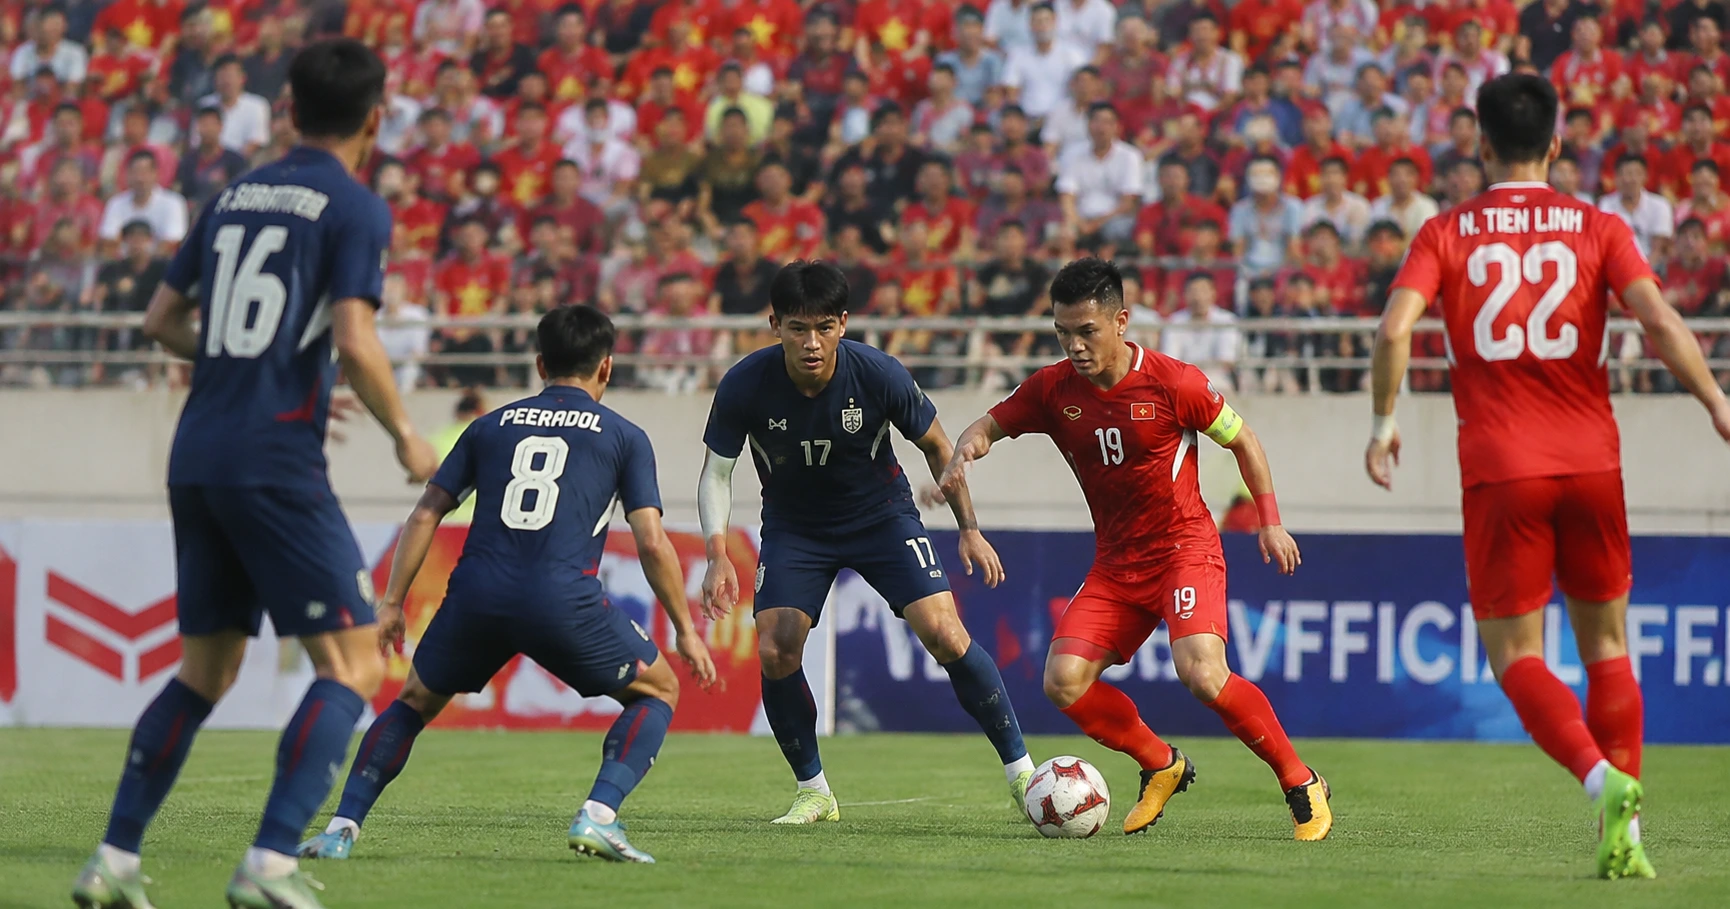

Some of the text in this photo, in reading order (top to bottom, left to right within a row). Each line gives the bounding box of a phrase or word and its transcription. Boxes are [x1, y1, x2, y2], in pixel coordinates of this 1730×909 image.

[1458, 206, 1583, 237] N. TIEN LINH
[206, 223, 289, 358] 16
[1467, 240, 1579, 362] 22
[499, 407, 602, 433] PEERADOL
[800, 439, 832, 466] 17
[1094, 427, 1125, 466] 19
[500, 435, 570, 531] 8
[905, 537, 936, 569] 17
[1173, 586, 1196, 614] 19
